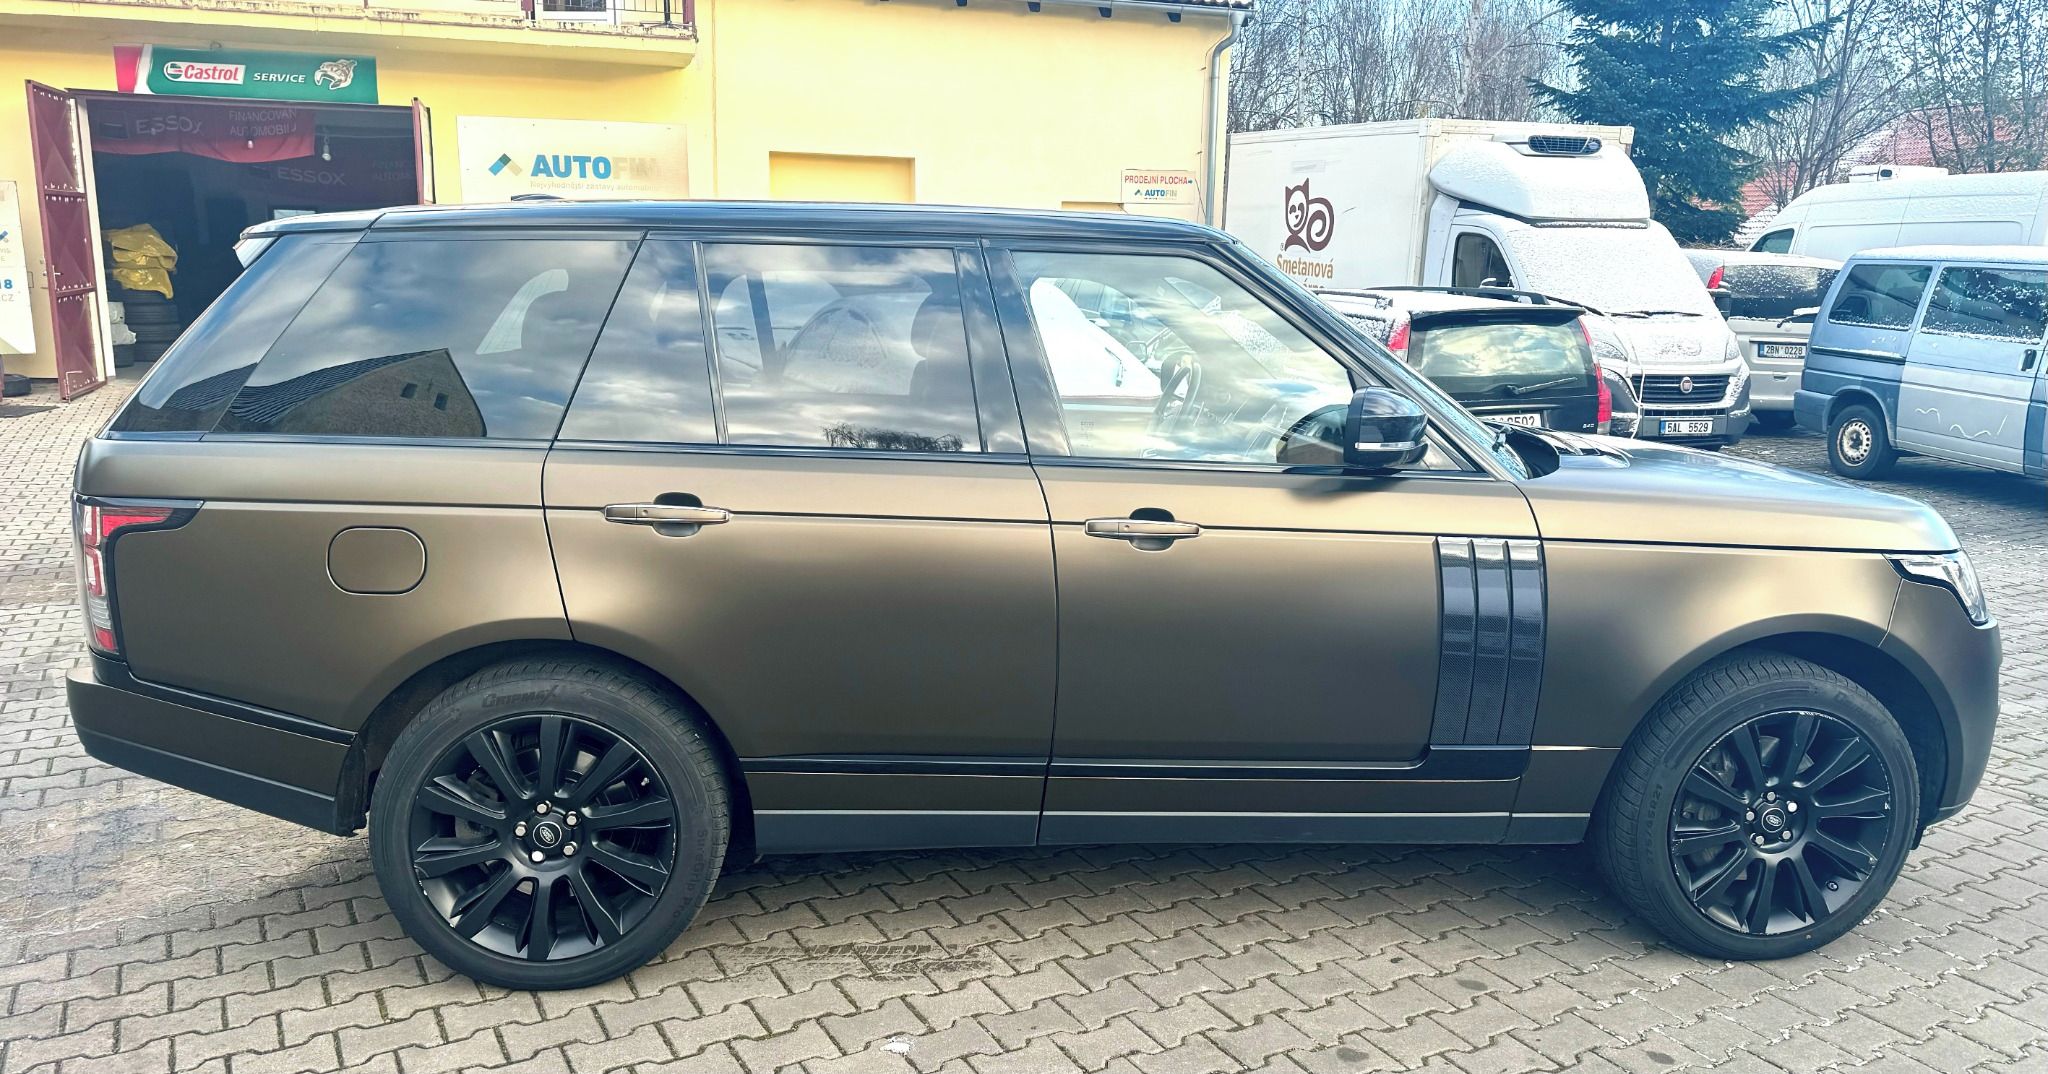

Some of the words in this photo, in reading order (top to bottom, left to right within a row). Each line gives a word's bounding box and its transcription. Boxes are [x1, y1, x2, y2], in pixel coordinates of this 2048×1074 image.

[184, 64, 239, 81] Castrol
[253, 72, 306, 83] SERVICE
[277, 167, 345, 185] ESSOX
[1160, 175, 1188, 185] PLOCHA
[1144, 189, 1178, 197] AUTOFIN
[1277, 253, 1334, 280] Smetanová
[1784, 346, 1803, 356] 0228
[1667, 422, 1682, 433] 5AL
[1688, 422, 1709, 433] 5529
